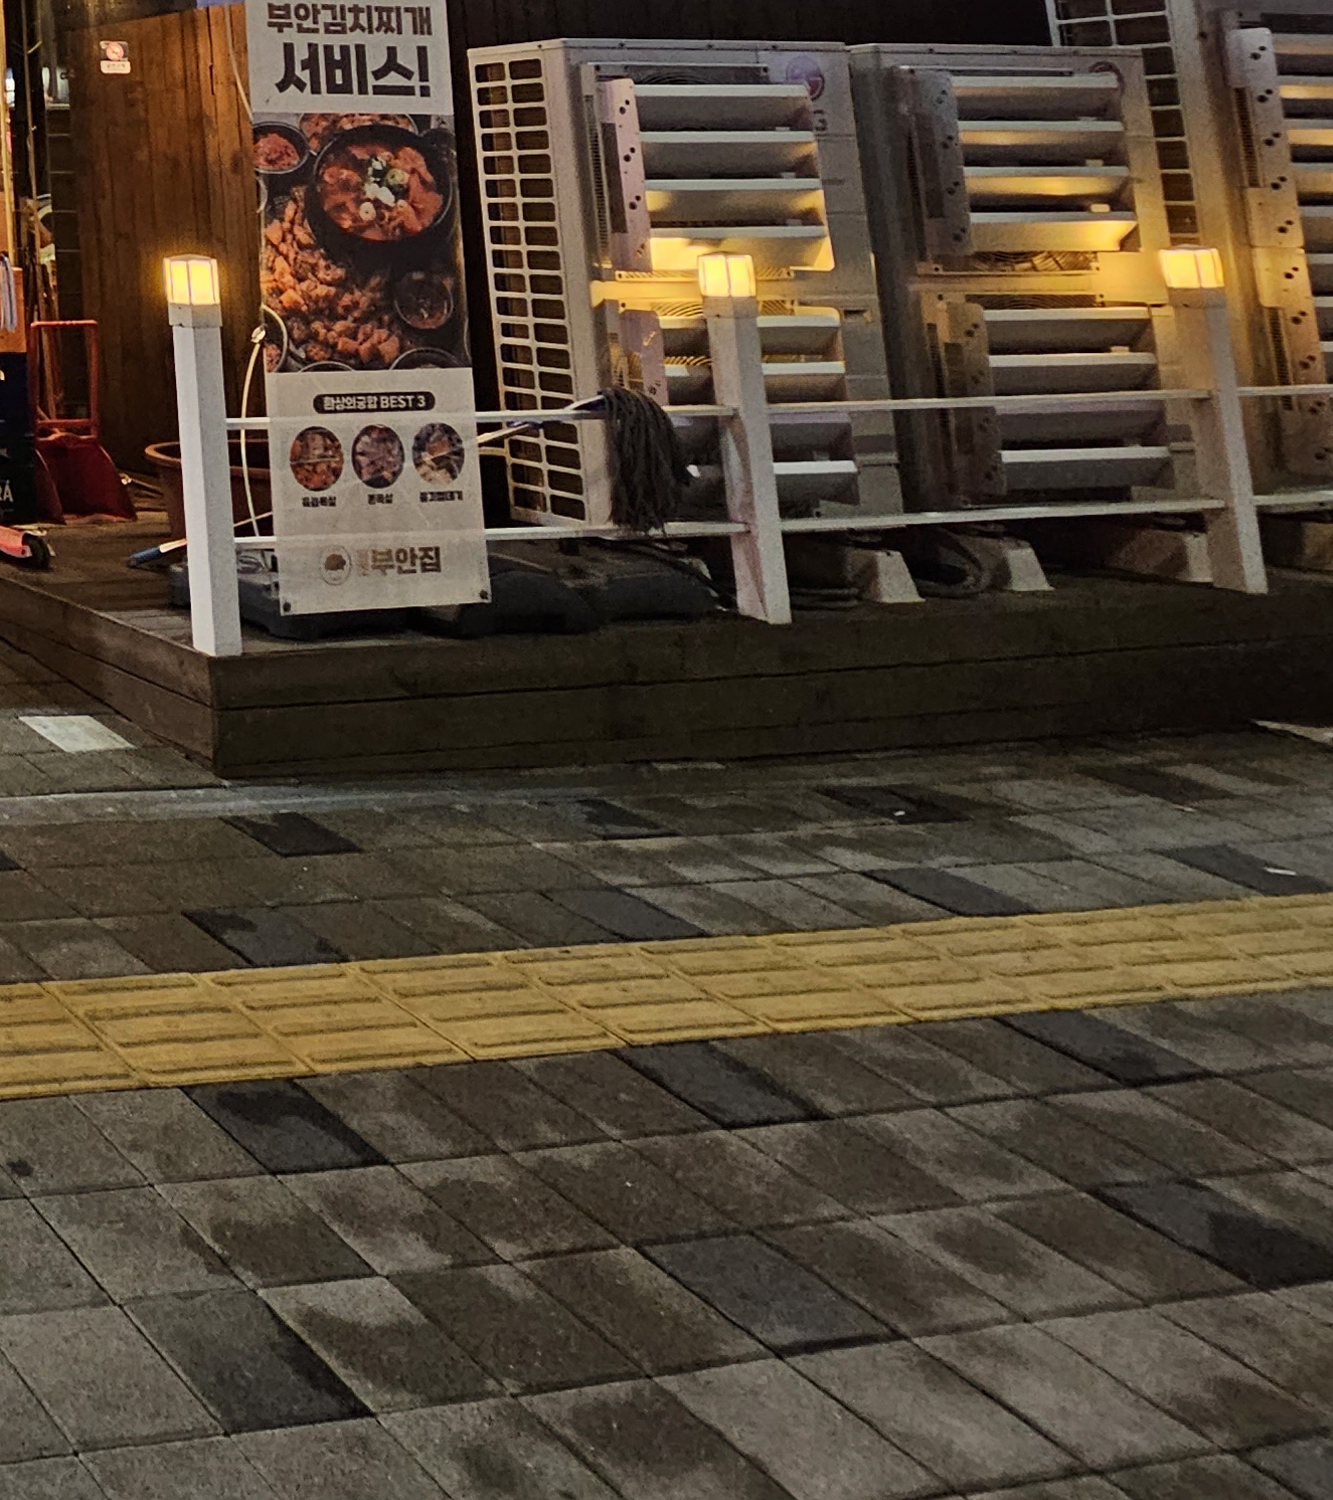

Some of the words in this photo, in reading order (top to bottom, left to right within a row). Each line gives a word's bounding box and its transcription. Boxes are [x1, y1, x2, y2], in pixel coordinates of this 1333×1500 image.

[266, 3, 433, 37] 부안김치찌개
[275, 42, 432, 98] 서비스!
[380, 394, 415, 409] BEST
[417, 394, 426, 408] 3
[370, 546, 442, 576] 부안집
